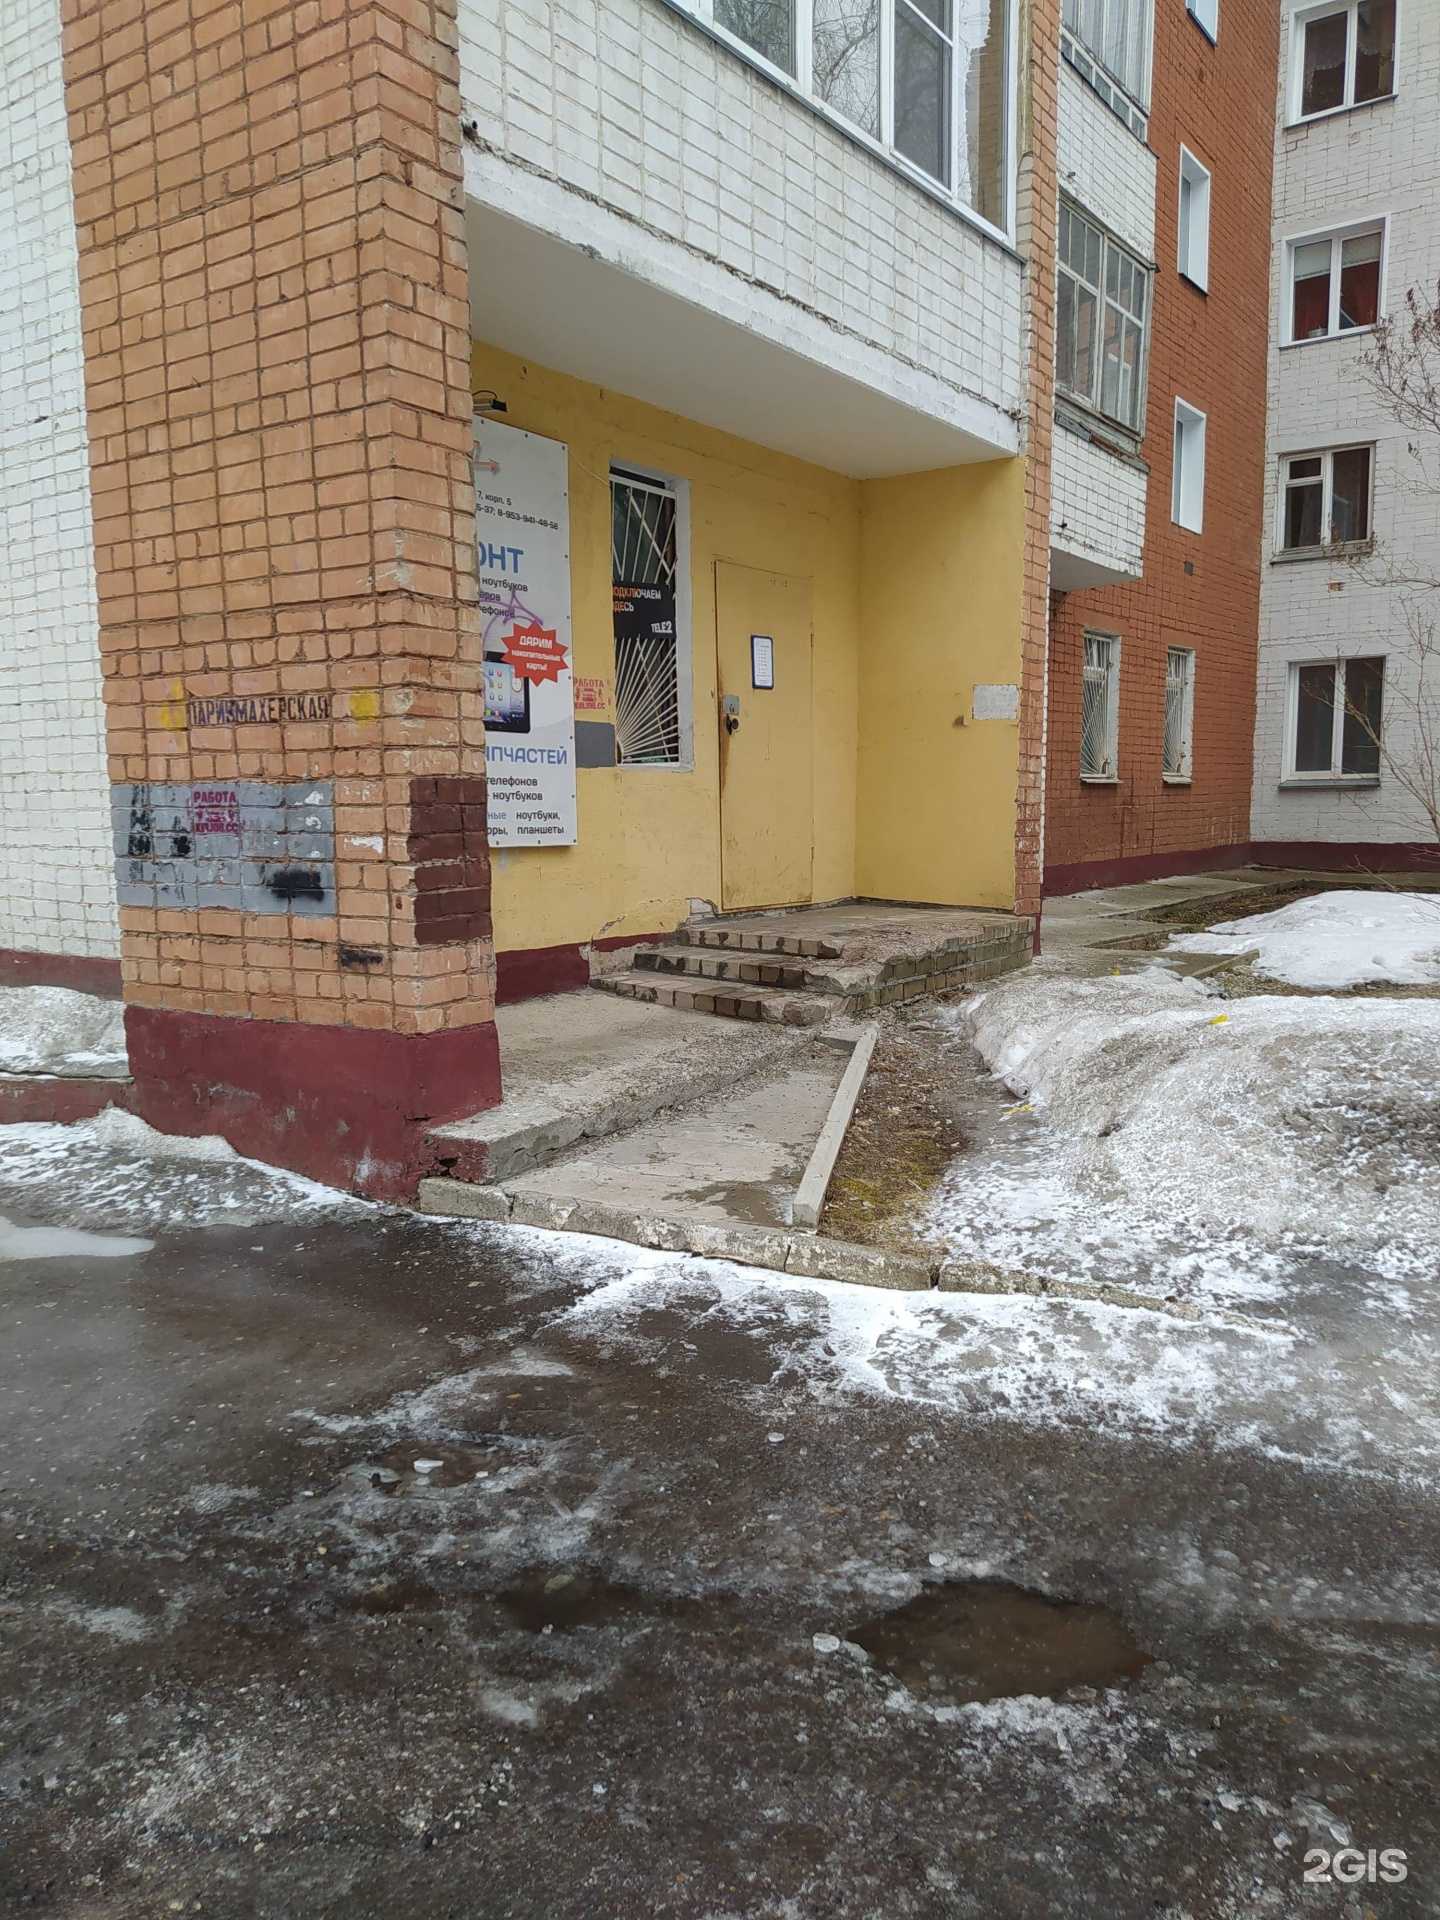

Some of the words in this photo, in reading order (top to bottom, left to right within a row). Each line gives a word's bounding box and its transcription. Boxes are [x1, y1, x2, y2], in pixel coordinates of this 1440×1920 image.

[506, 497, 512, 506] 5
[482, 577, 529, 592] ноутбуков
[651, 620, 673, 634] TELE2
[520, 635, 553, 650] ДАРИМ
[193, 791, 236, 803] РАБОТА
[493, 791, 543, 802] ноутбуков
[516, 810, 561, 822] ноутбуки,
[517, 826, 564, 835] планшеты
